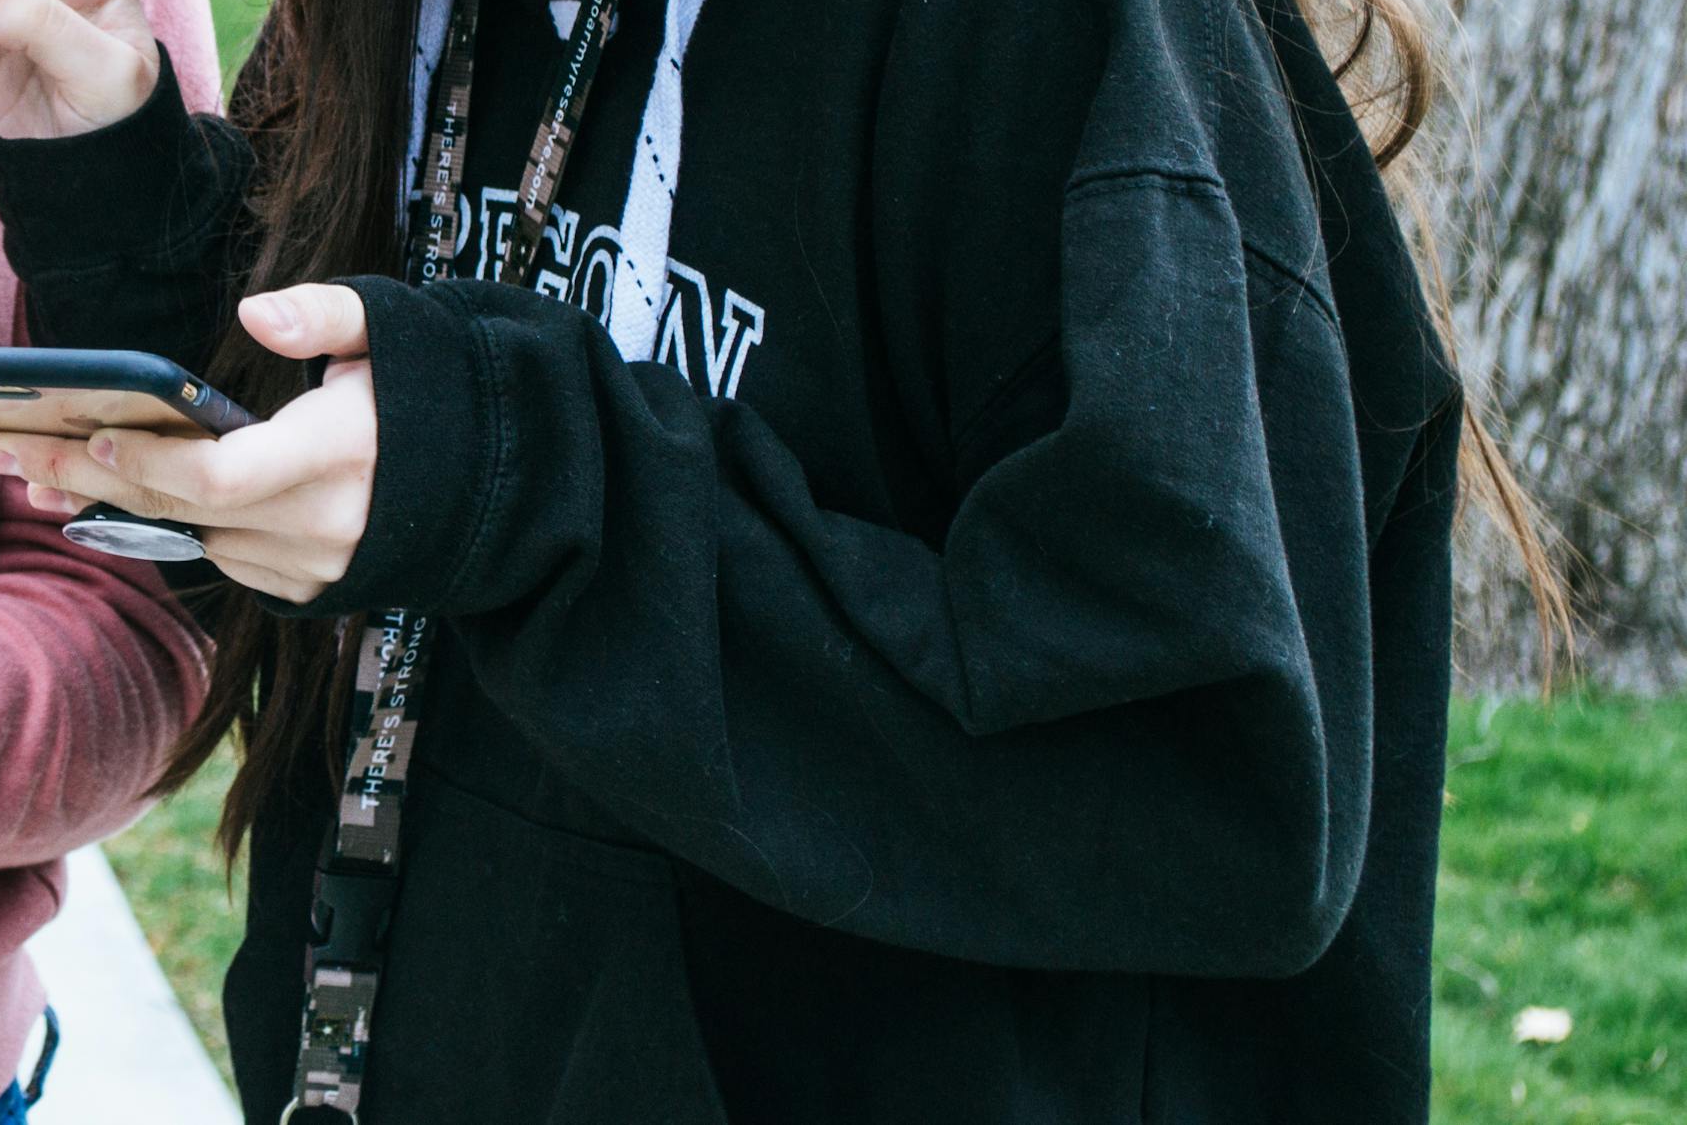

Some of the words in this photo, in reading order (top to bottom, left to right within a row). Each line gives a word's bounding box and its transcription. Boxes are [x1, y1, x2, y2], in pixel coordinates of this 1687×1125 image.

[433, 102, 457, 206] THERE'S
[421, 215, 444, 285] STRO
[360, 714, 400, 810] THERE'S
[390, 615, 426, 707] STRONG
